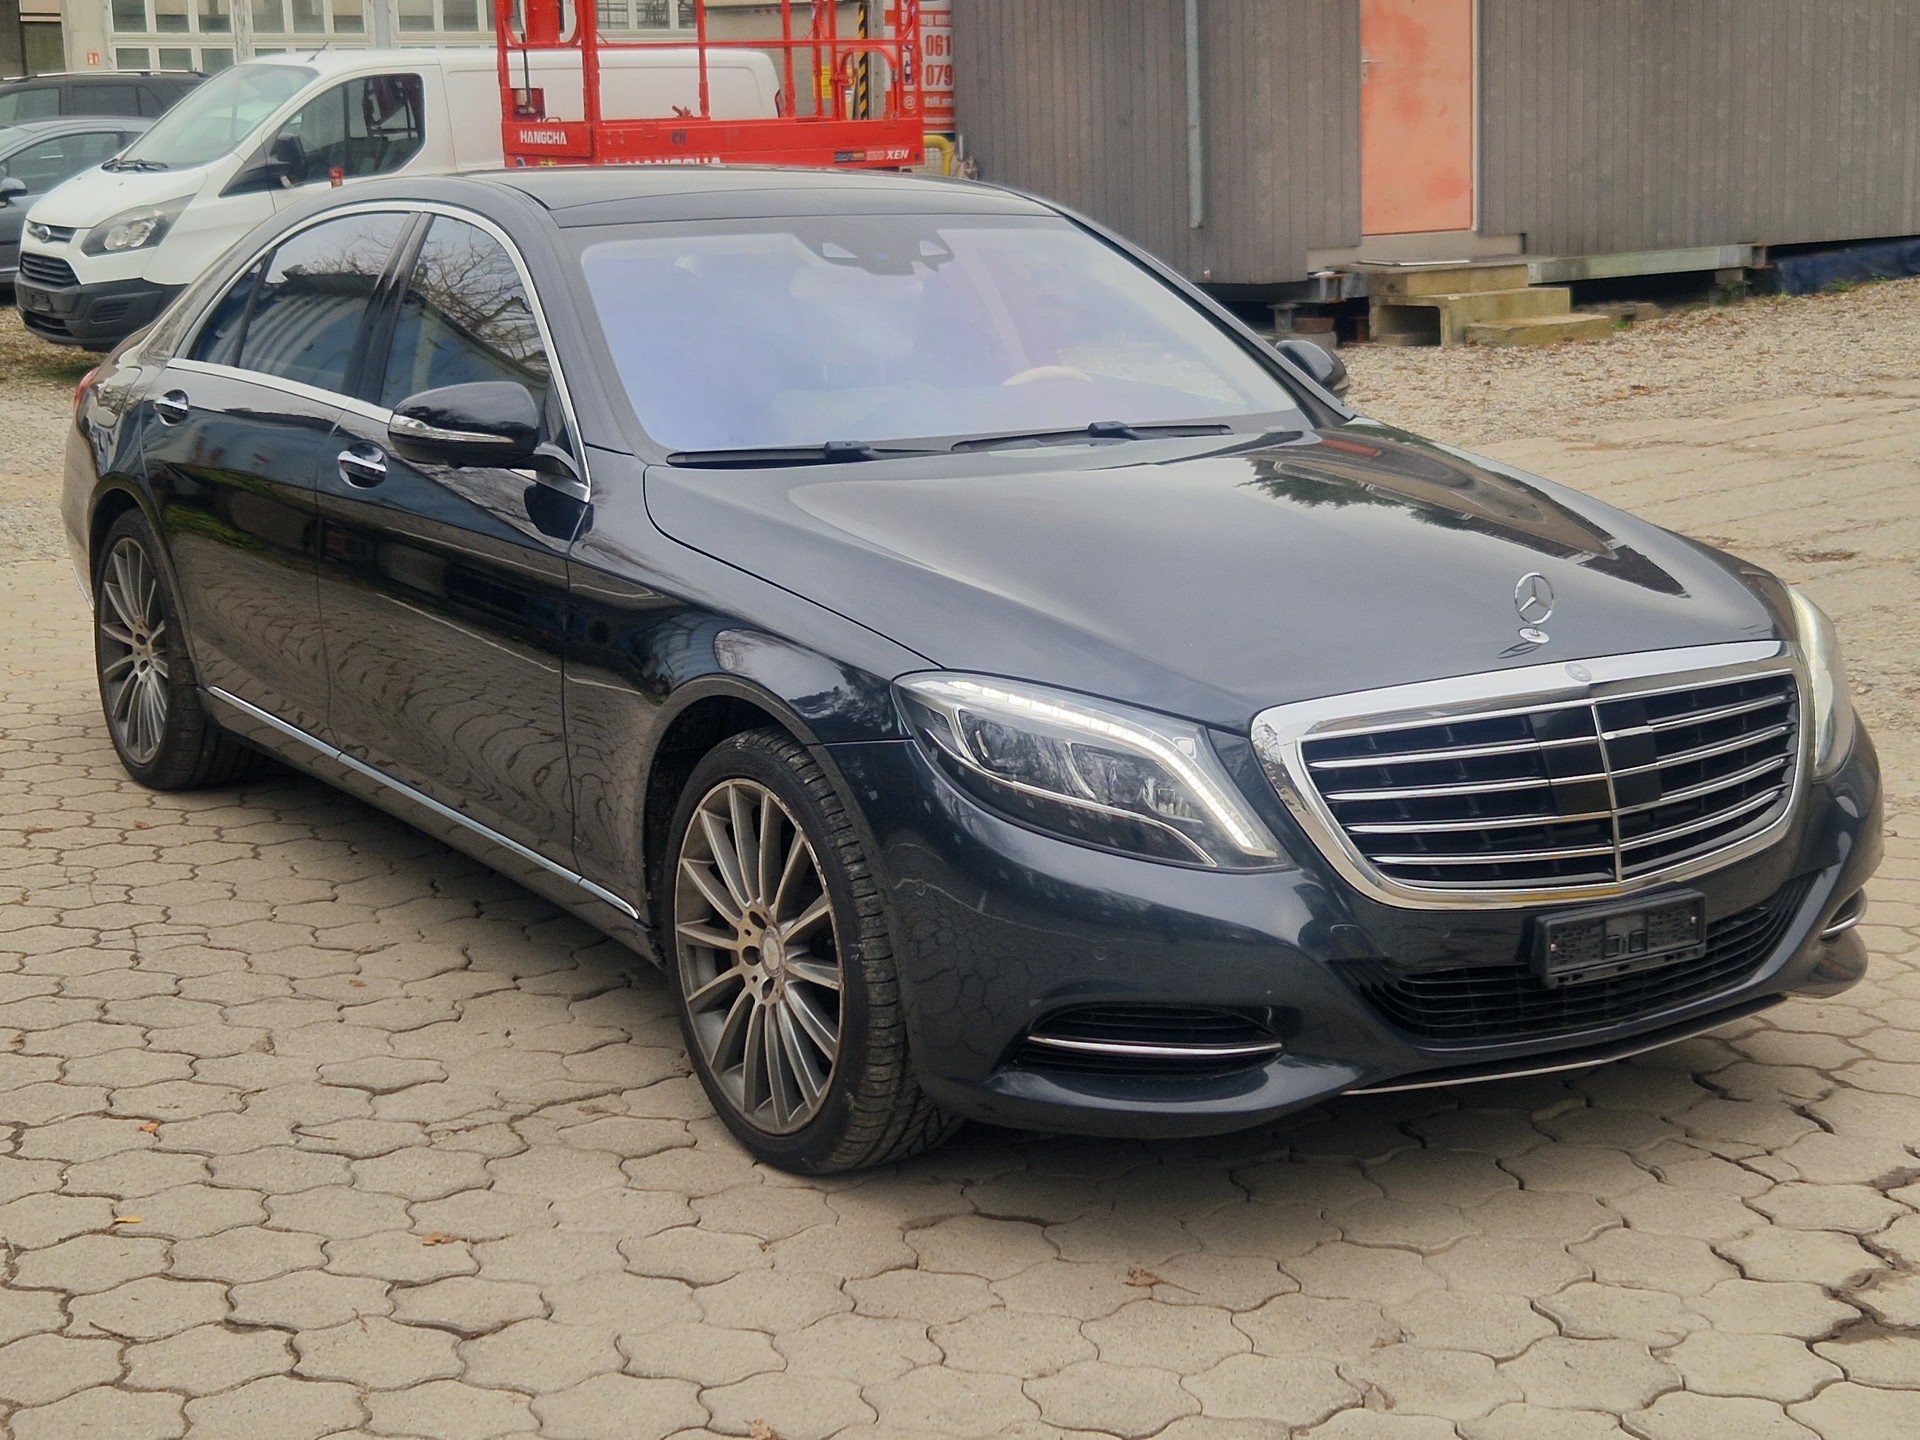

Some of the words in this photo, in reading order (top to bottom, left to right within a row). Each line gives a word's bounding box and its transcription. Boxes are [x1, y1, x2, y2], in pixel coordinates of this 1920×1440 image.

[925, 35, 951, 56] 061
[925, 64, 953, 86] 079
[520, 130, 568, 146] HANGCHA
[886, 149, 909, 160] XEN
